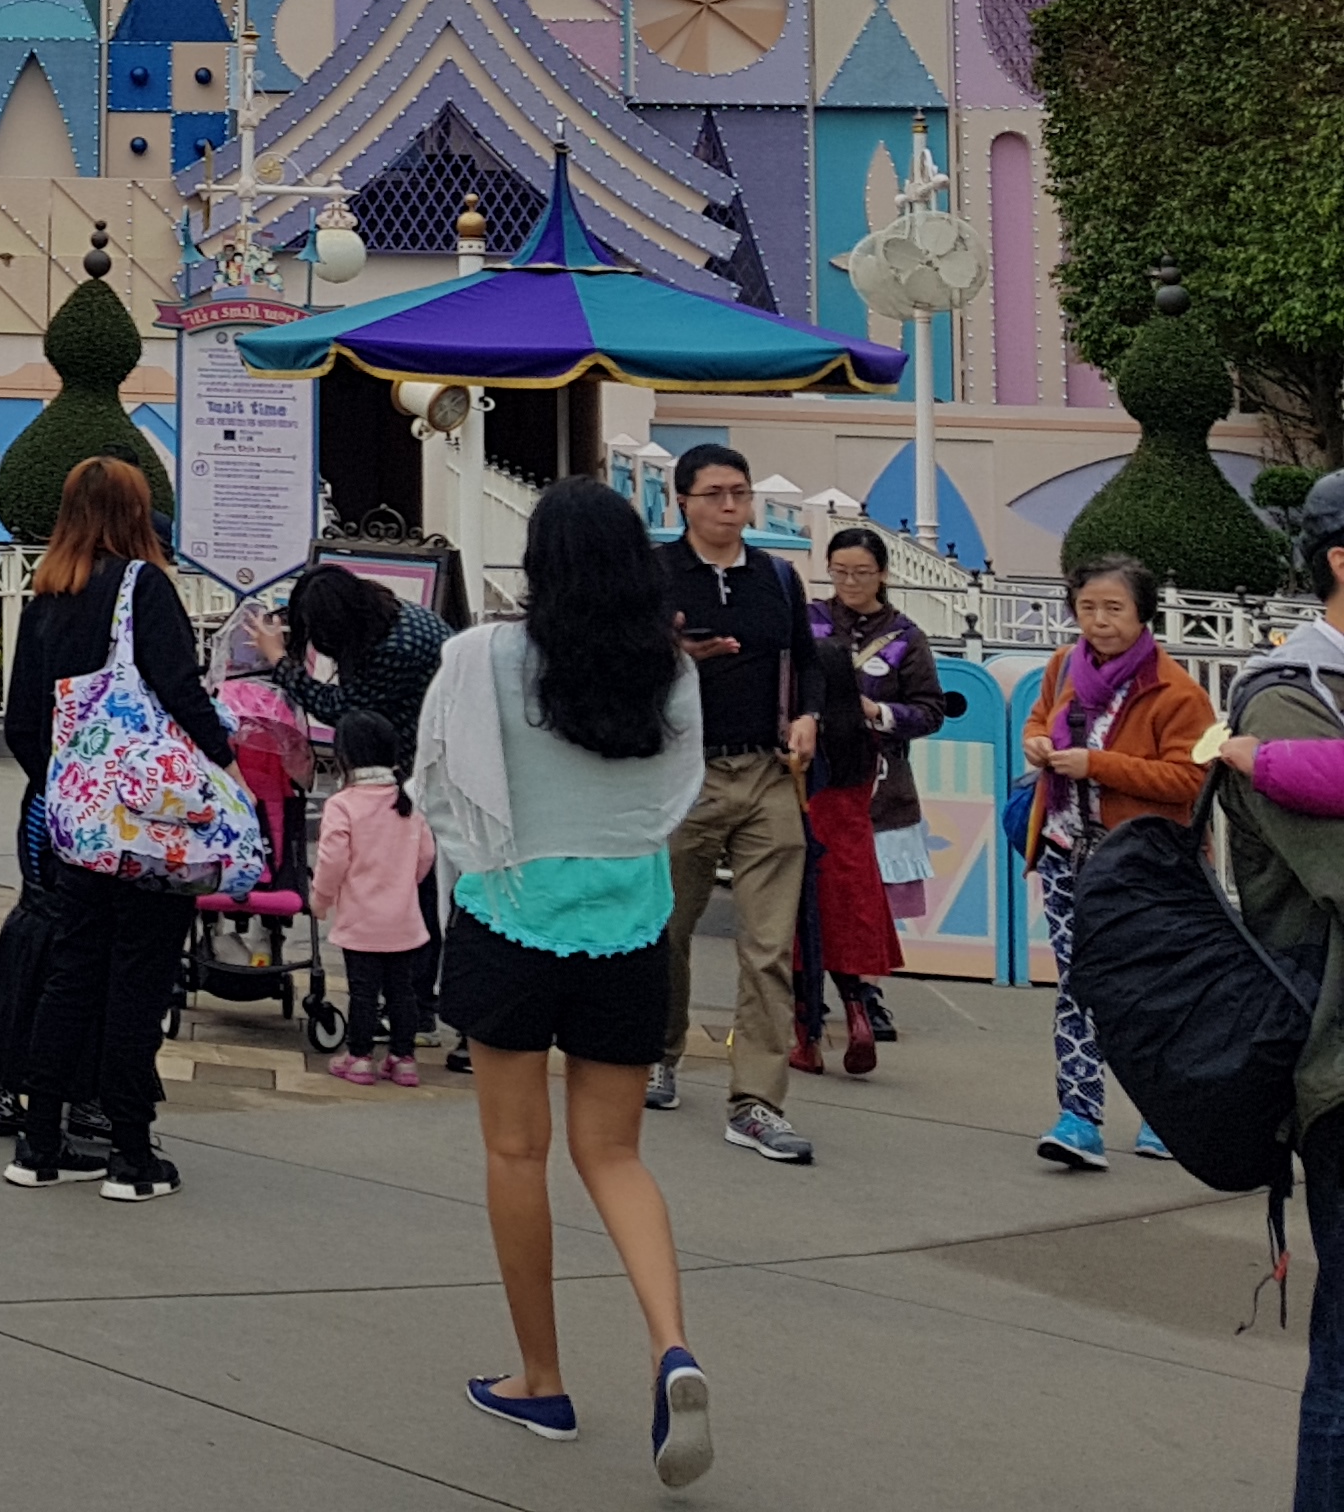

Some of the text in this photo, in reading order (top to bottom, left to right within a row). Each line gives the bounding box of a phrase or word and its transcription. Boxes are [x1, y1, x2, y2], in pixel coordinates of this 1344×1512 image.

[221, 303, 262, 320] small
[250, 401, 287, 416] time
[75, 759, 117, 825] DEVILKIN
